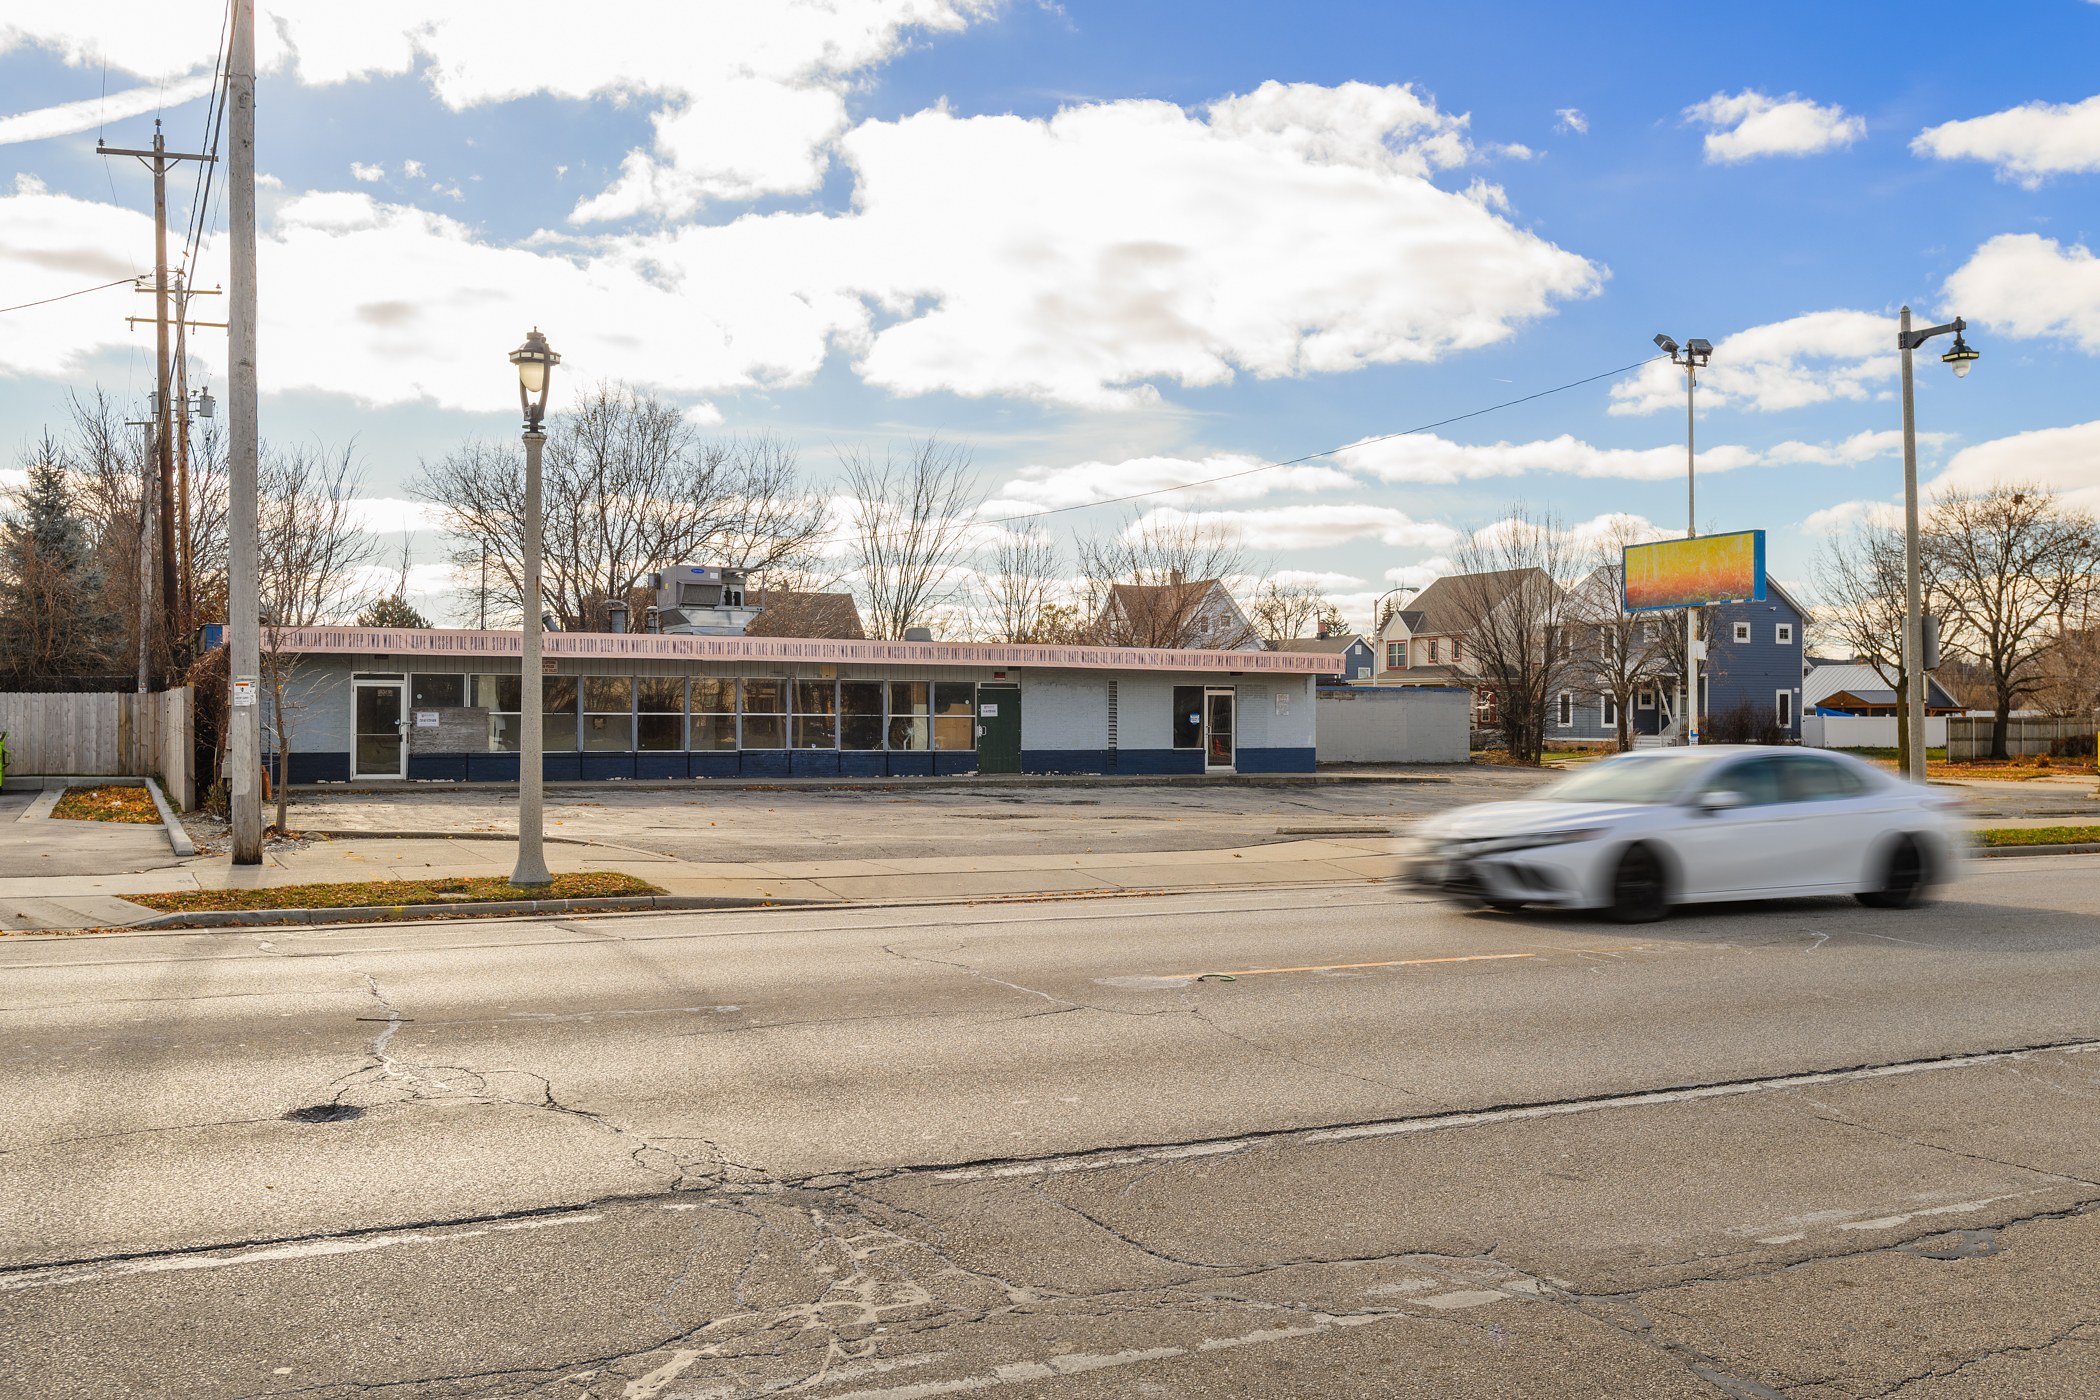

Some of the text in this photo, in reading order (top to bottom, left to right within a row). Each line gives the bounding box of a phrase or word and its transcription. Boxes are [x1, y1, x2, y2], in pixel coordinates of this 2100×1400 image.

[290, 632, 322, 647] FAMILIAR
[325, 633, 345, 647] STORY
[348, 633, 364, 648] STEP
[367, 633, 380, 648] TWO
[383, 634, 402, 648] WRITE
[405, 634, 408, 649] I
[411, 635, 426, 649] HAVE
[429, 635, 453, 650] MISSED
[456, 636, 467, 650] THE
[470, 636, 488, 650] POINT
[492, 636, 507, 651] STEP
[509, 637, 521, 651] ONE
[548, 638, 577, 652] FAMILIAR
[579, 638, 597, 652] STORY
[600, 639, 614, 653] STEP
[617, 639, 629, 653] TWO
[631, 639, 648, 653] WRITE
[651, 640, 654, 653] I
[656, 640, 670, 654] HAVE
[672, 640, 693, 654] MISSED
[696, 641, 705, 654] THE
[708, 641, 725, 655] POINT
[727, 642, 740, 655] STEP
[743, 642, 753, 655] ONE
[755, 642, 768, 656] TAKE
[770, 643, 775, 656] A
[776, 643, 802, 657] FAMILIAR
[804, 644, 821, 657] STORY
[823, 644, 835, 657] STEP
[837, 645, 848, 658] TWO
[850, 645, 866, 658] WRITE
[872, 645, 885, 659] HAVE
[887, 646, 906, 659] MISSED
[908, 646, 918, 659] THE
[919, 646, 934, 660] POINT
[937, 647, 949, 660] STEP
